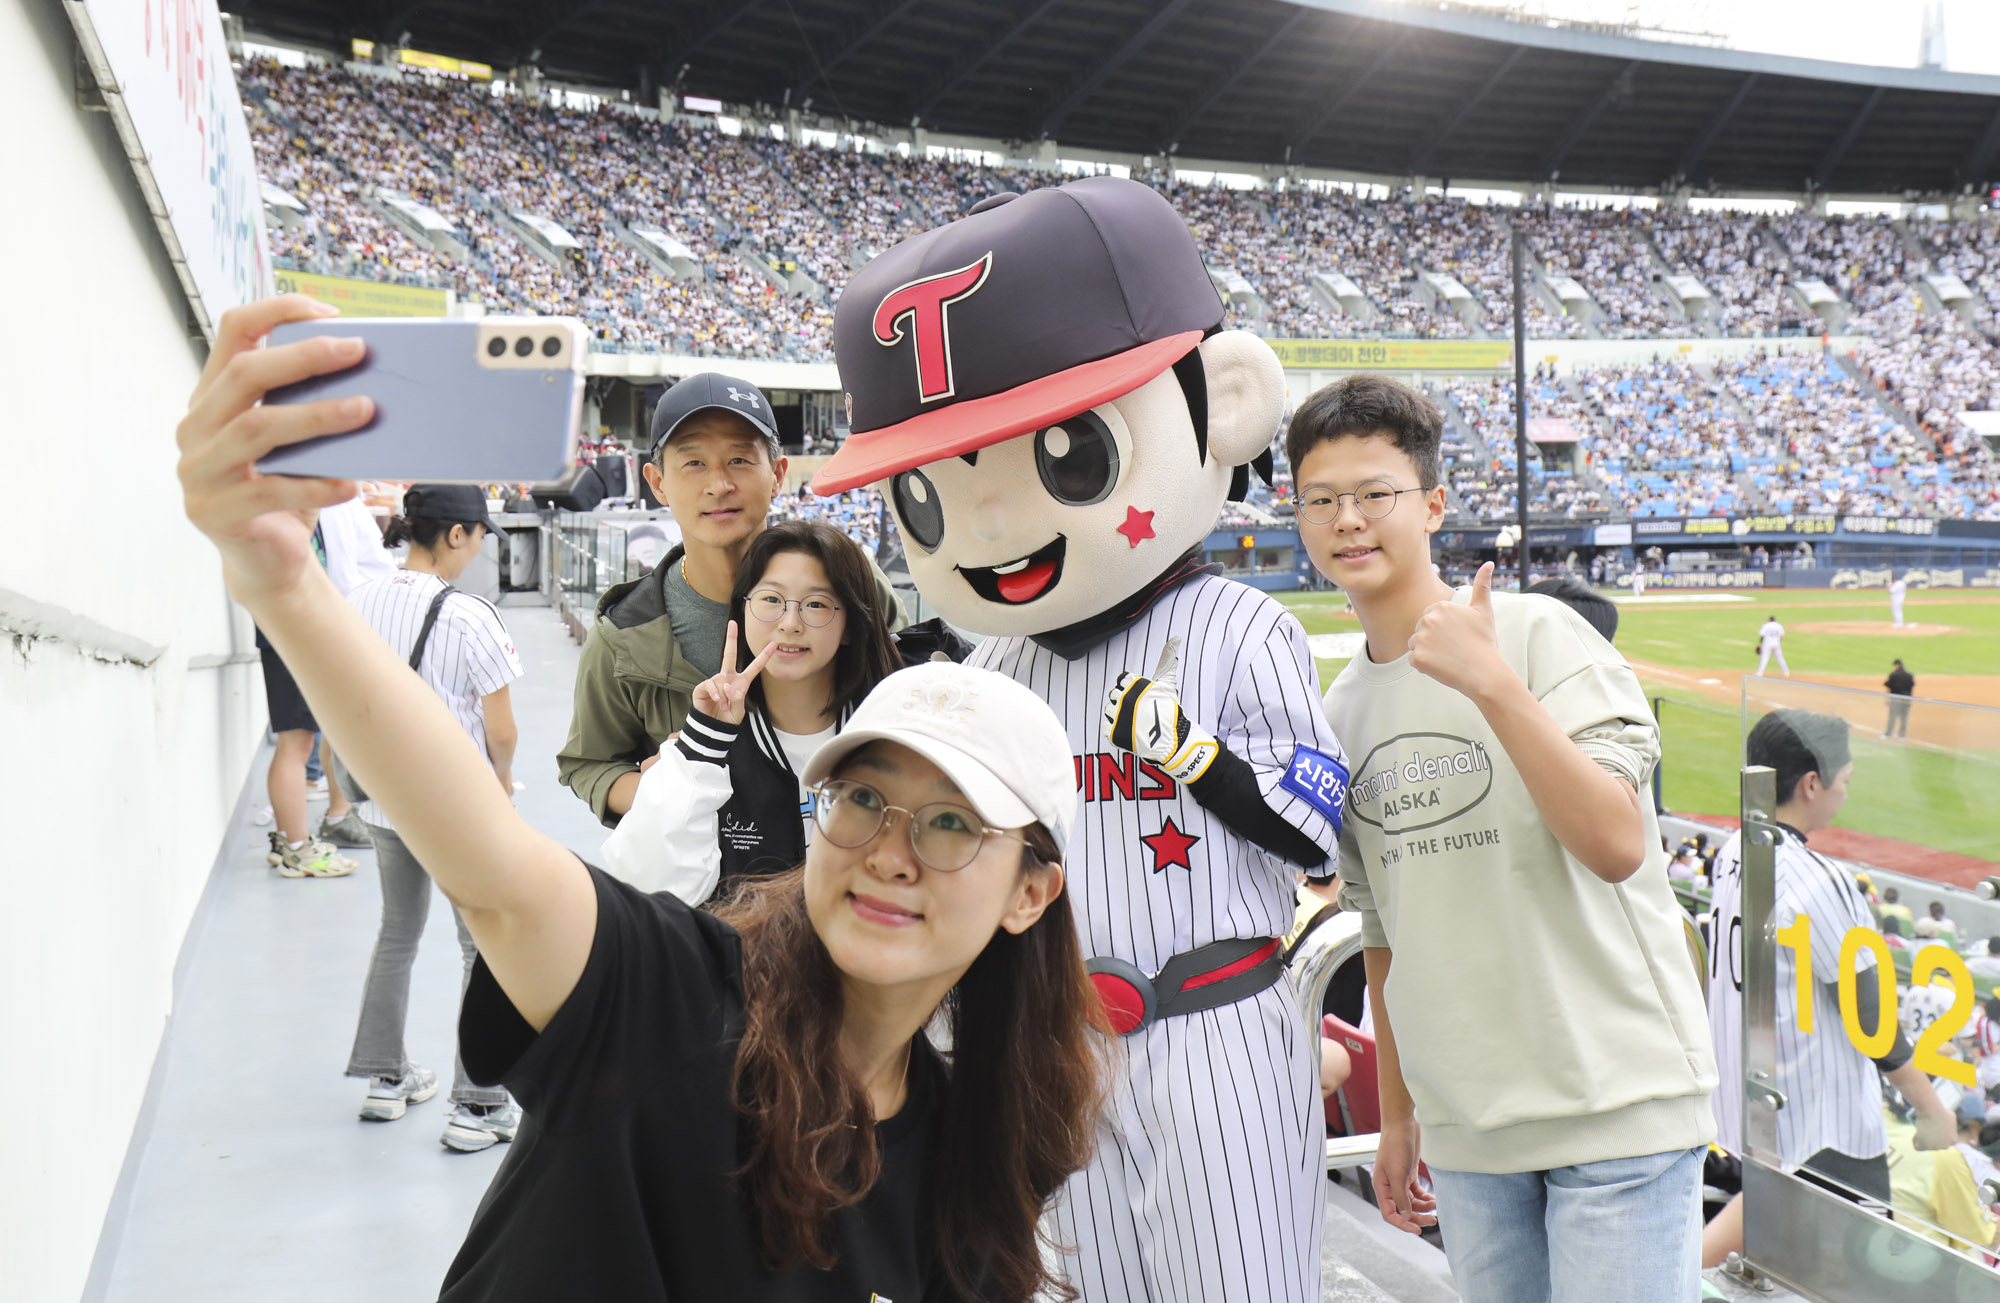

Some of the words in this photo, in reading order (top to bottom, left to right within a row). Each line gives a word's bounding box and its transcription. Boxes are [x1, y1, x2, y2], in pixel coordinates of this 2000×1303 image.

[873, 251, 993, 404] T
[1073, 752, 1176, 802] INS
[1174, 746, 1206, 779] RO-SPECS
[1402, 740, 1489, 783] denali
[1406, 838, 1439, 857] THE
[1443, 828, 1501, 852] FUTURE
[1776, 913, 1978, 1089] 102
